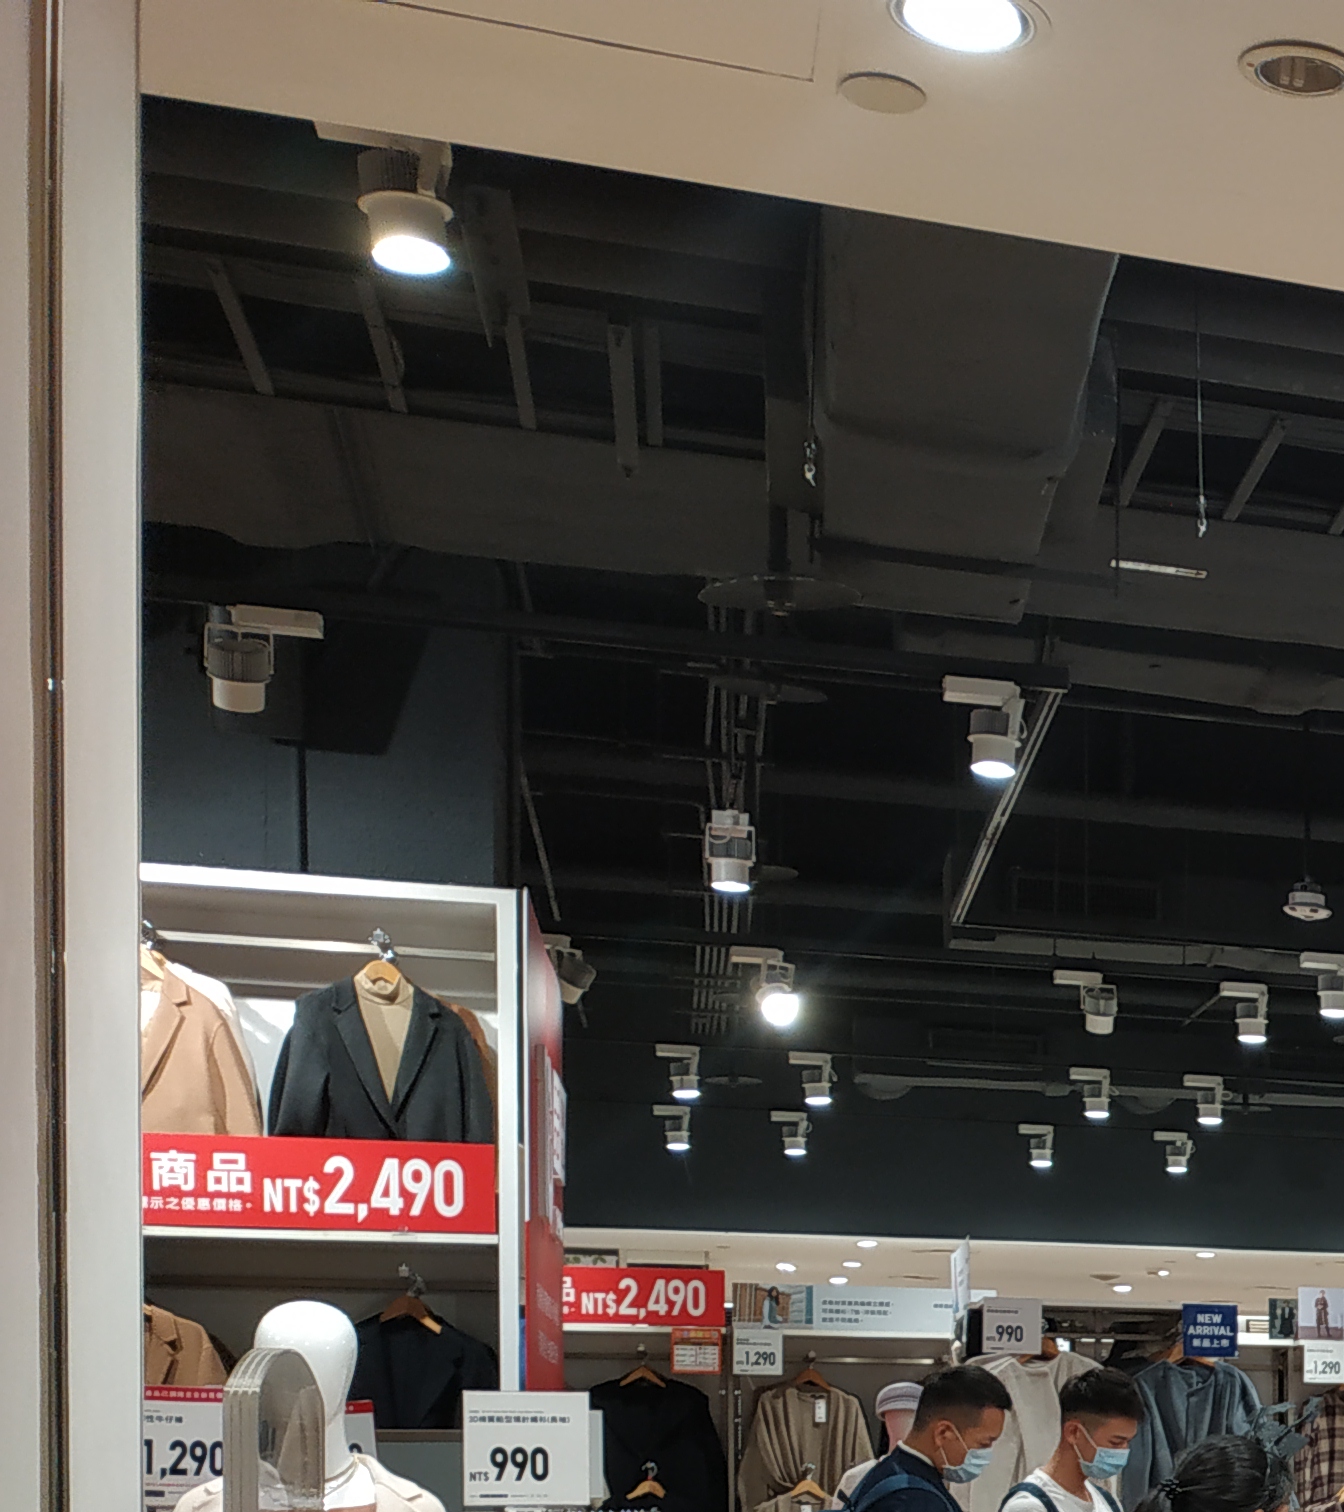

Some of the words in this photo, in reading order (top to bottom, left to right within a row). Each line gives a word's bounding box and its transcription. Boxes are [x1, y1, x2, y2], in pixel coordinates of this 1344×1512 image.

[150, 1149, 252, 1193] 商品
[262, 1155, 465, 1223] NT$2,490
[581, 1278, 706, 1321] NT$2,490
[1196, 1313, 1222, 1324] NEW
[1187, 1325, 1234, 1337] ARRIVAL
[1192, 1338, 1230, 1347] 新品上市
[469, 1446, 549, 1482] NT$990
